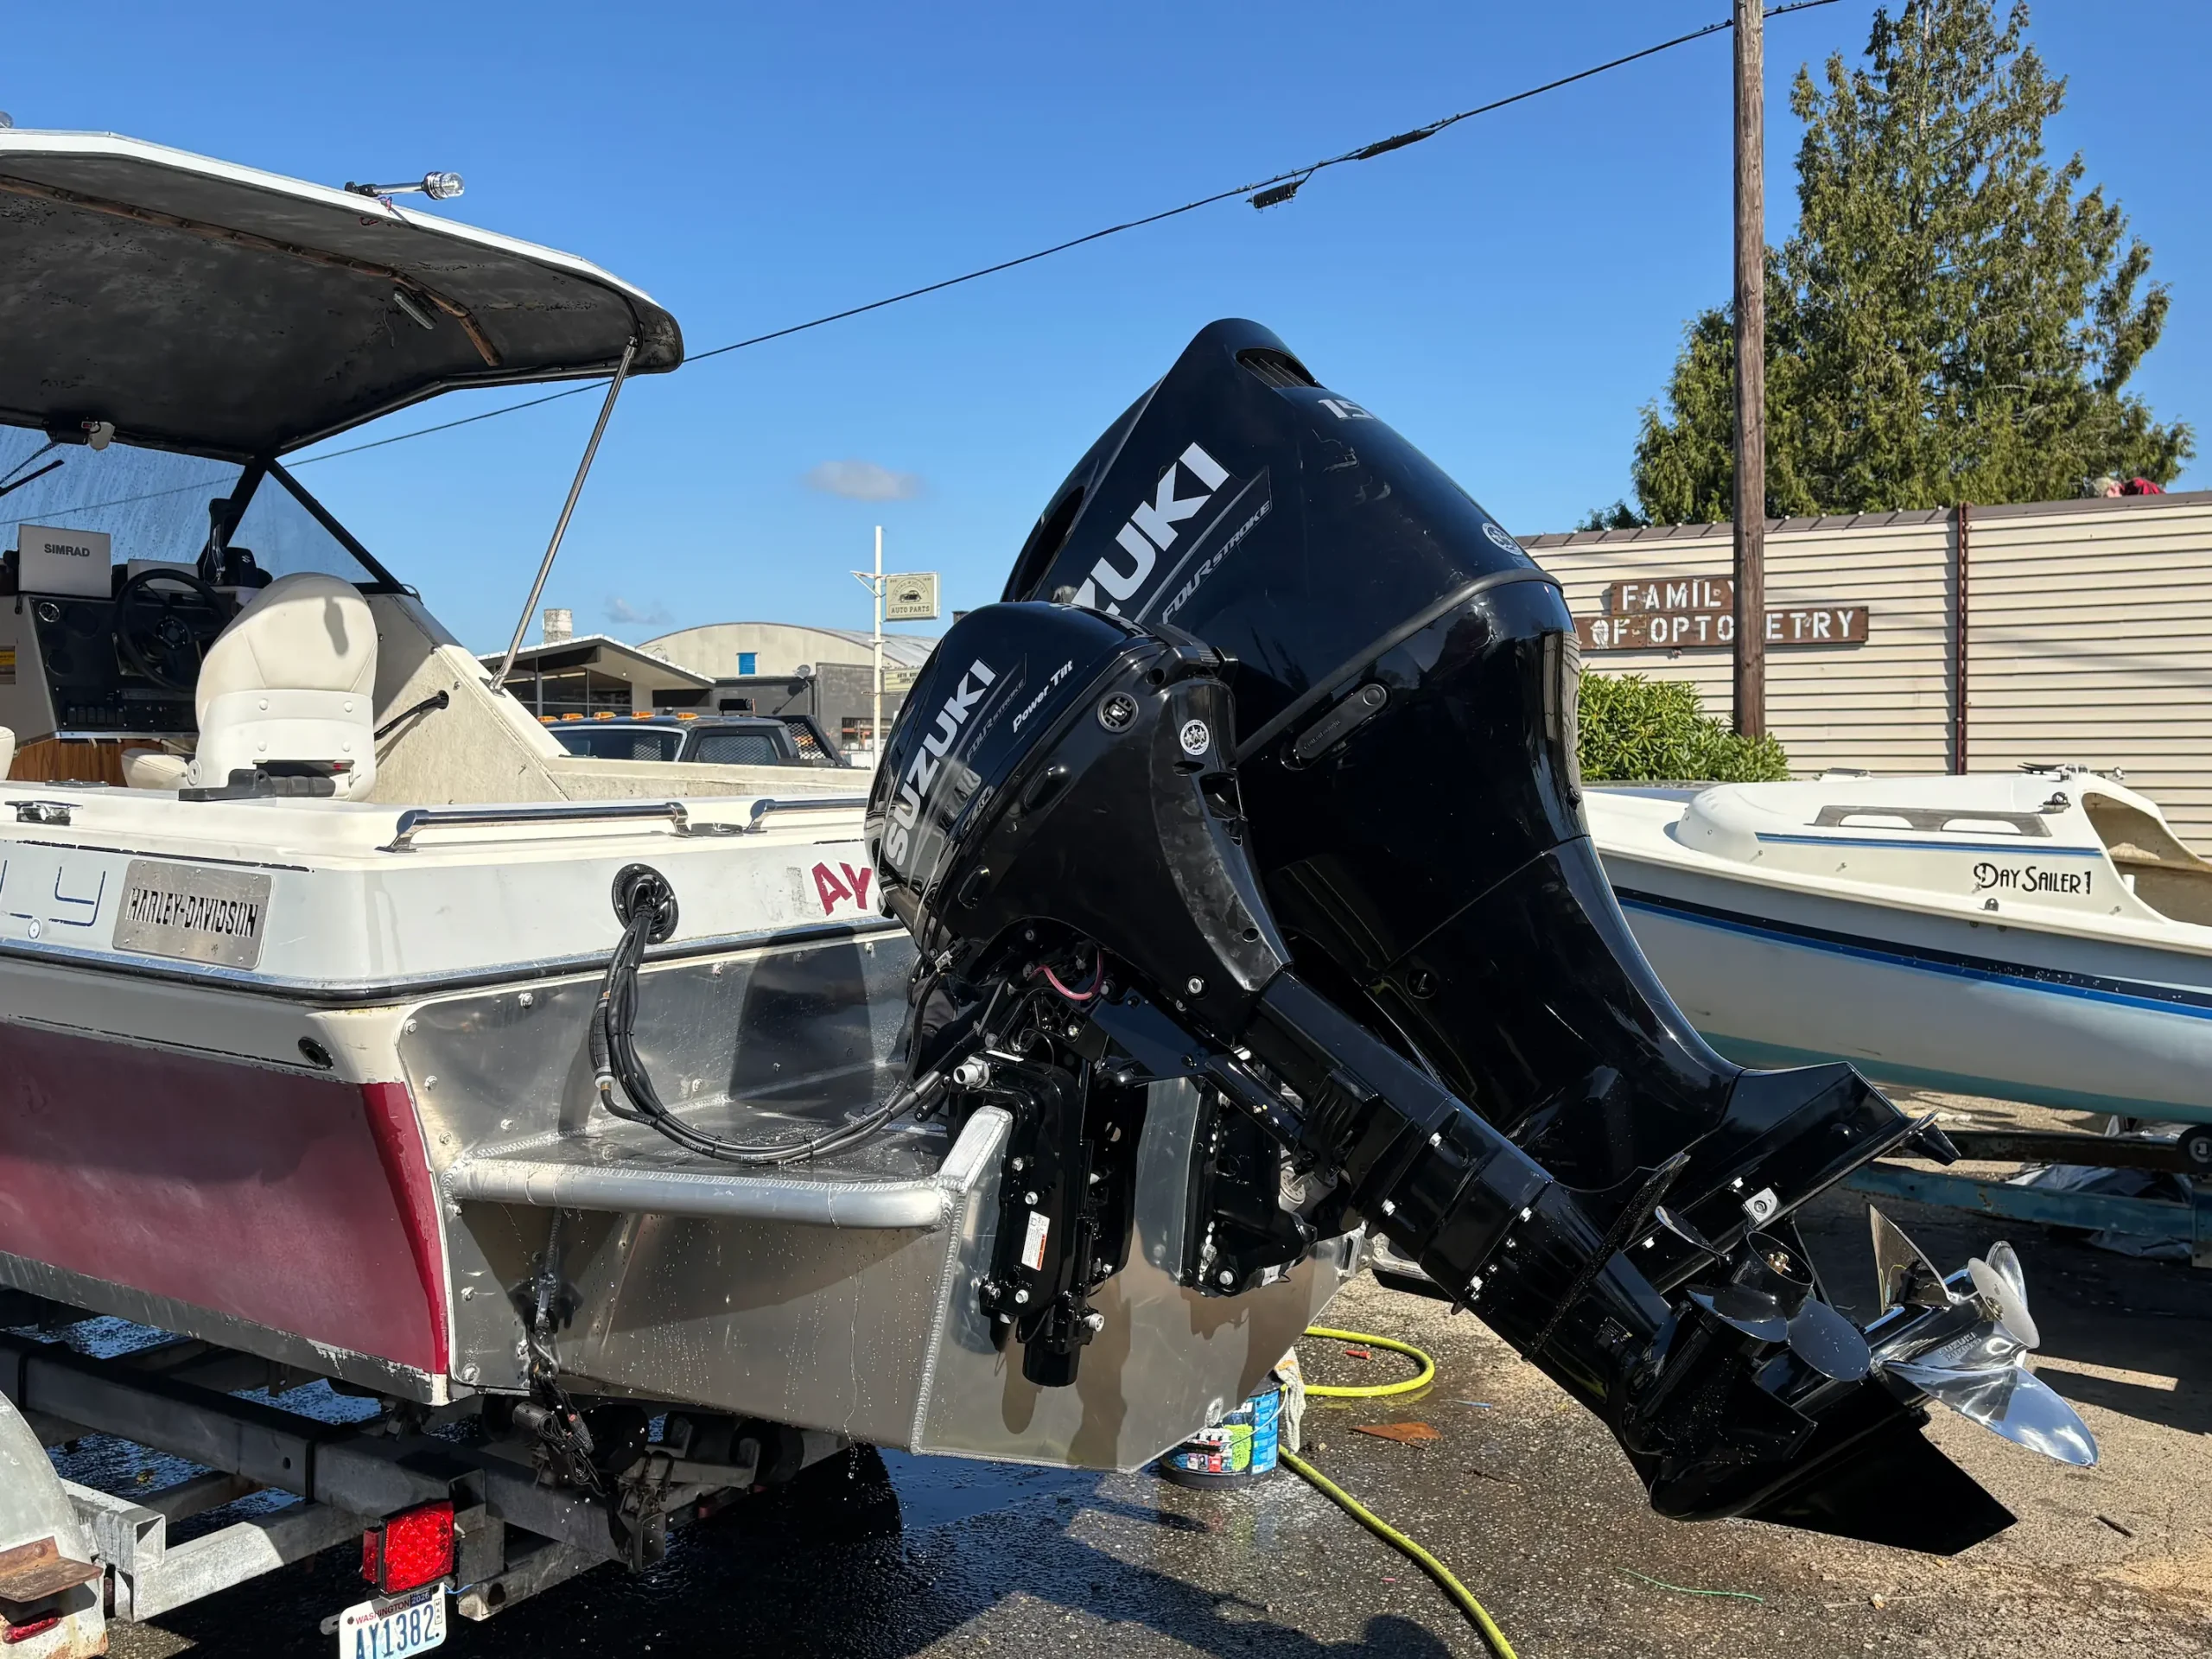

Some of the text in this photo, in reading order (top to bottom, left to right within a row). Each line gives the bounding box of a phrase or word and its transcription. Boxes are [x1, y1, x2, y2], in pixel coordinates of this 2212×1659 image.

[44, 543, 90, 557] SIMRAD
[1622, 581, 1733, 611] FAMIL
[1592, 610, 1854, 646] OF OPTOETRY
[1013, 659, 1072, 733] Power Tilt
[887, 659, 996, 866] SUZUKI
[2084, 871, 2091, 894] 1
[125, 887, 259, 938] HARLEY-DAVIDSON
[356, 1599, 410, 1624] WASHINGTON
[411, 1592, 430, 1605] 2026
[356, 1605, 435, 1659] AY1382
